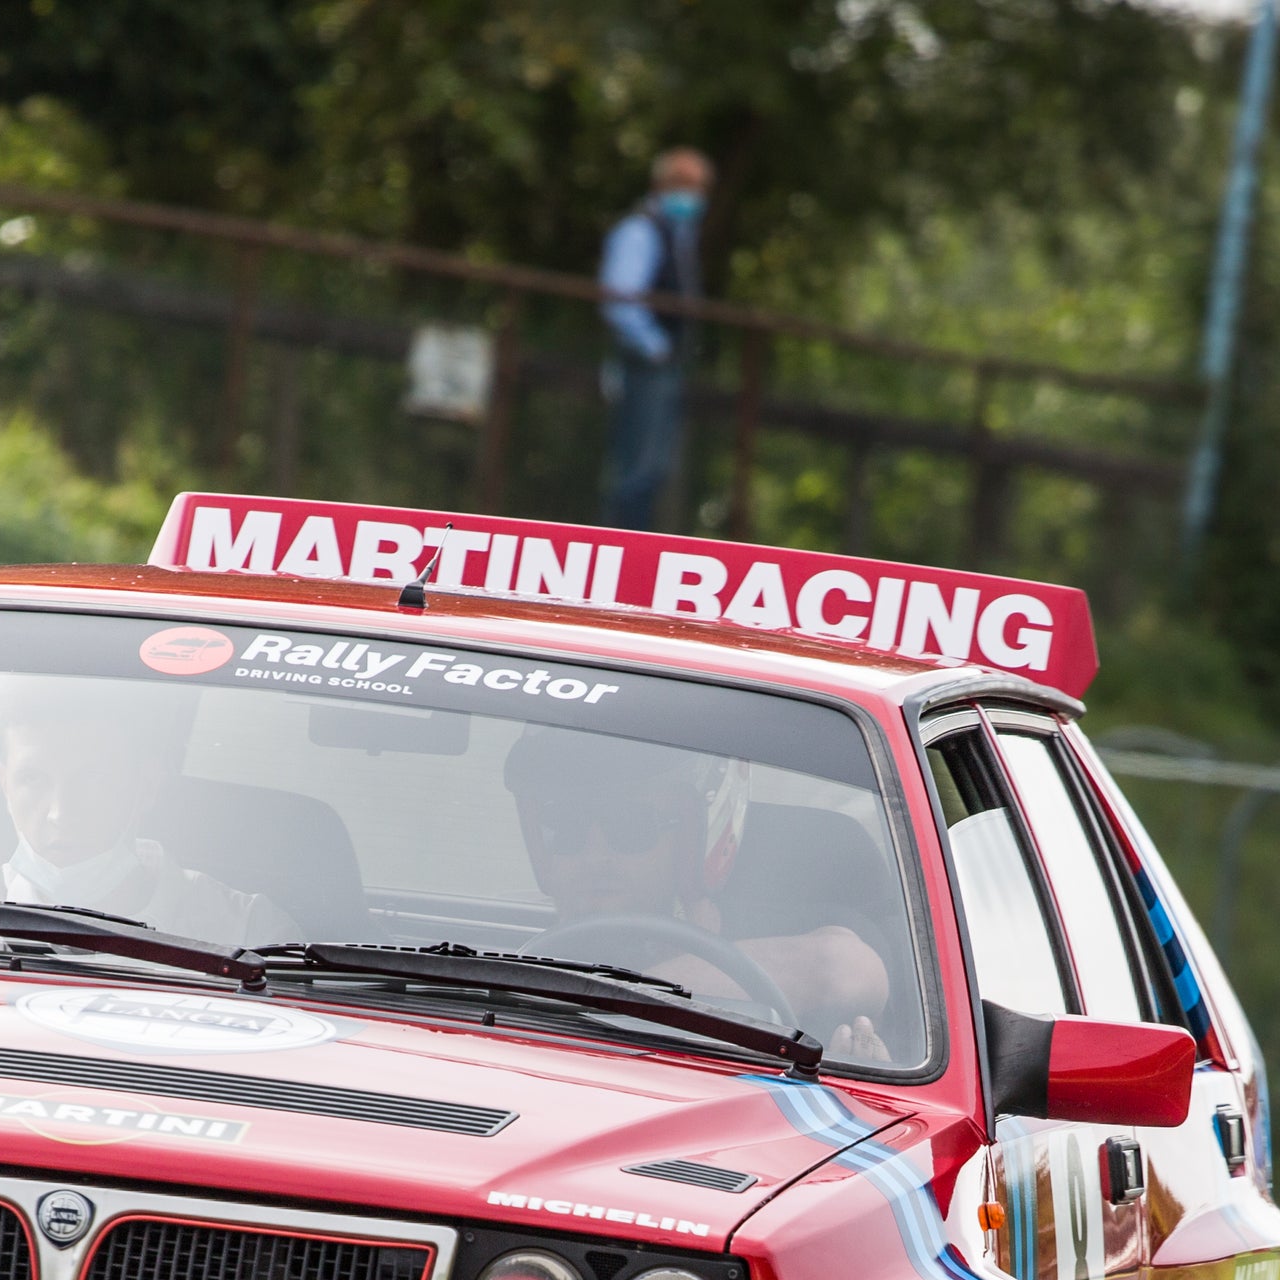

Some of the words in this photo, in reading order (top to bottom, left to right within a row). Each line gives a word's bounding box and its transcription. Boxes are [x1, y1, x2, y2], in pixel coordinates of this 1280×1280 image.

[186, 507, 624, 604] MARTINI
[651, 551, 1054, 672] RACING
[235, 668, 322, 685] DRIVING
[327, 677, 414, 695] SCHOOL
[240, 634, 407, 678] Rally
[405, 652, 620, 704] Factor
[96, 1002, 261, 1031] LANCIA
[487, 1191, 710, 1237] MICHELIN
